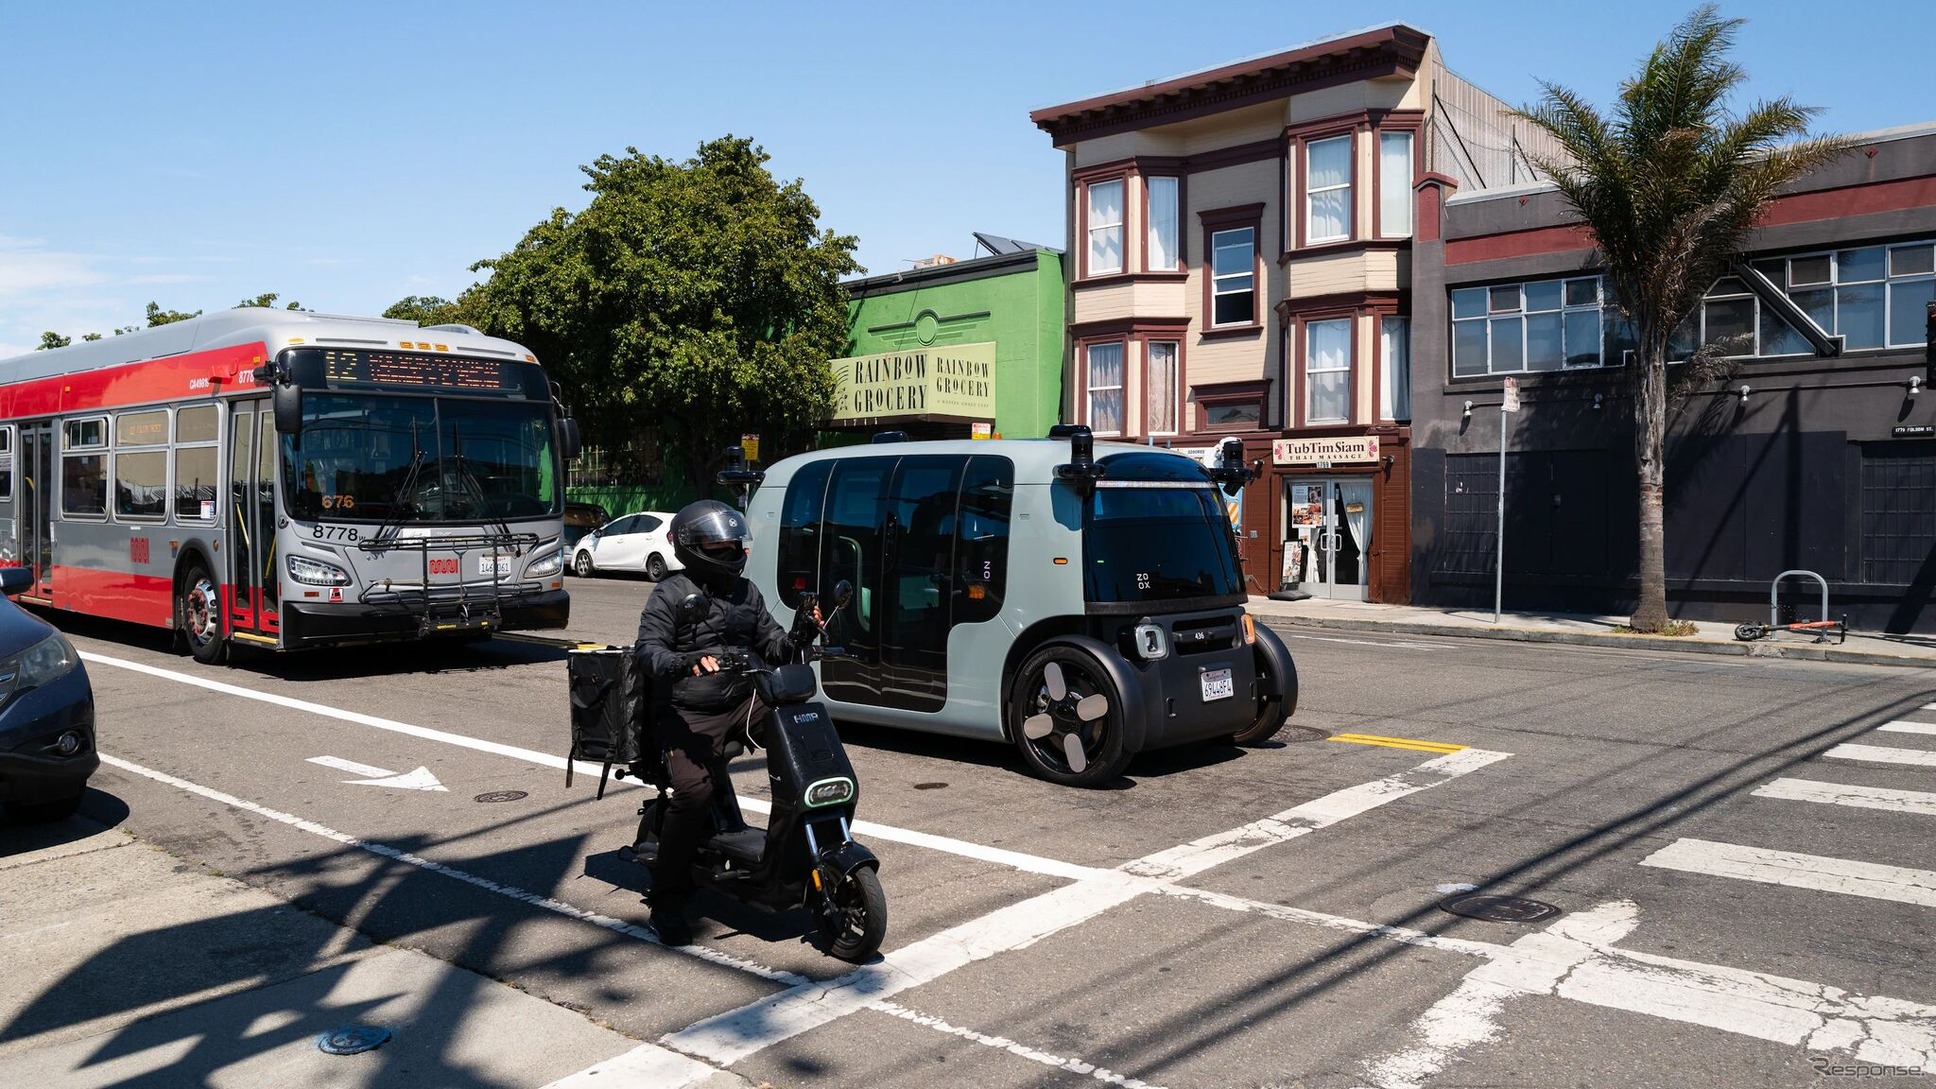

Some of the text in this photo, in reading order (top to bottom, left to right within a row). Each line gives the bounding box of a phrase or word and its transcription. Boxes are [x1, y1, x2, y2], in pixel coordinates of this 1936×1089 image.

[326, 351, 358, 380] 12
[855, 353, 927, 384] RAINBOW
[937, 357, 989, 379] RAINBOW
[238, 369, 255, 384] 8778
[936, 377, 989, 398] GROCERY
[854, 384, 927, 413] GROCERY
[322, 495, 354, 509] 676
[313, 525, 358, 541] 8778
[481, 563, 509, 573] 146061
